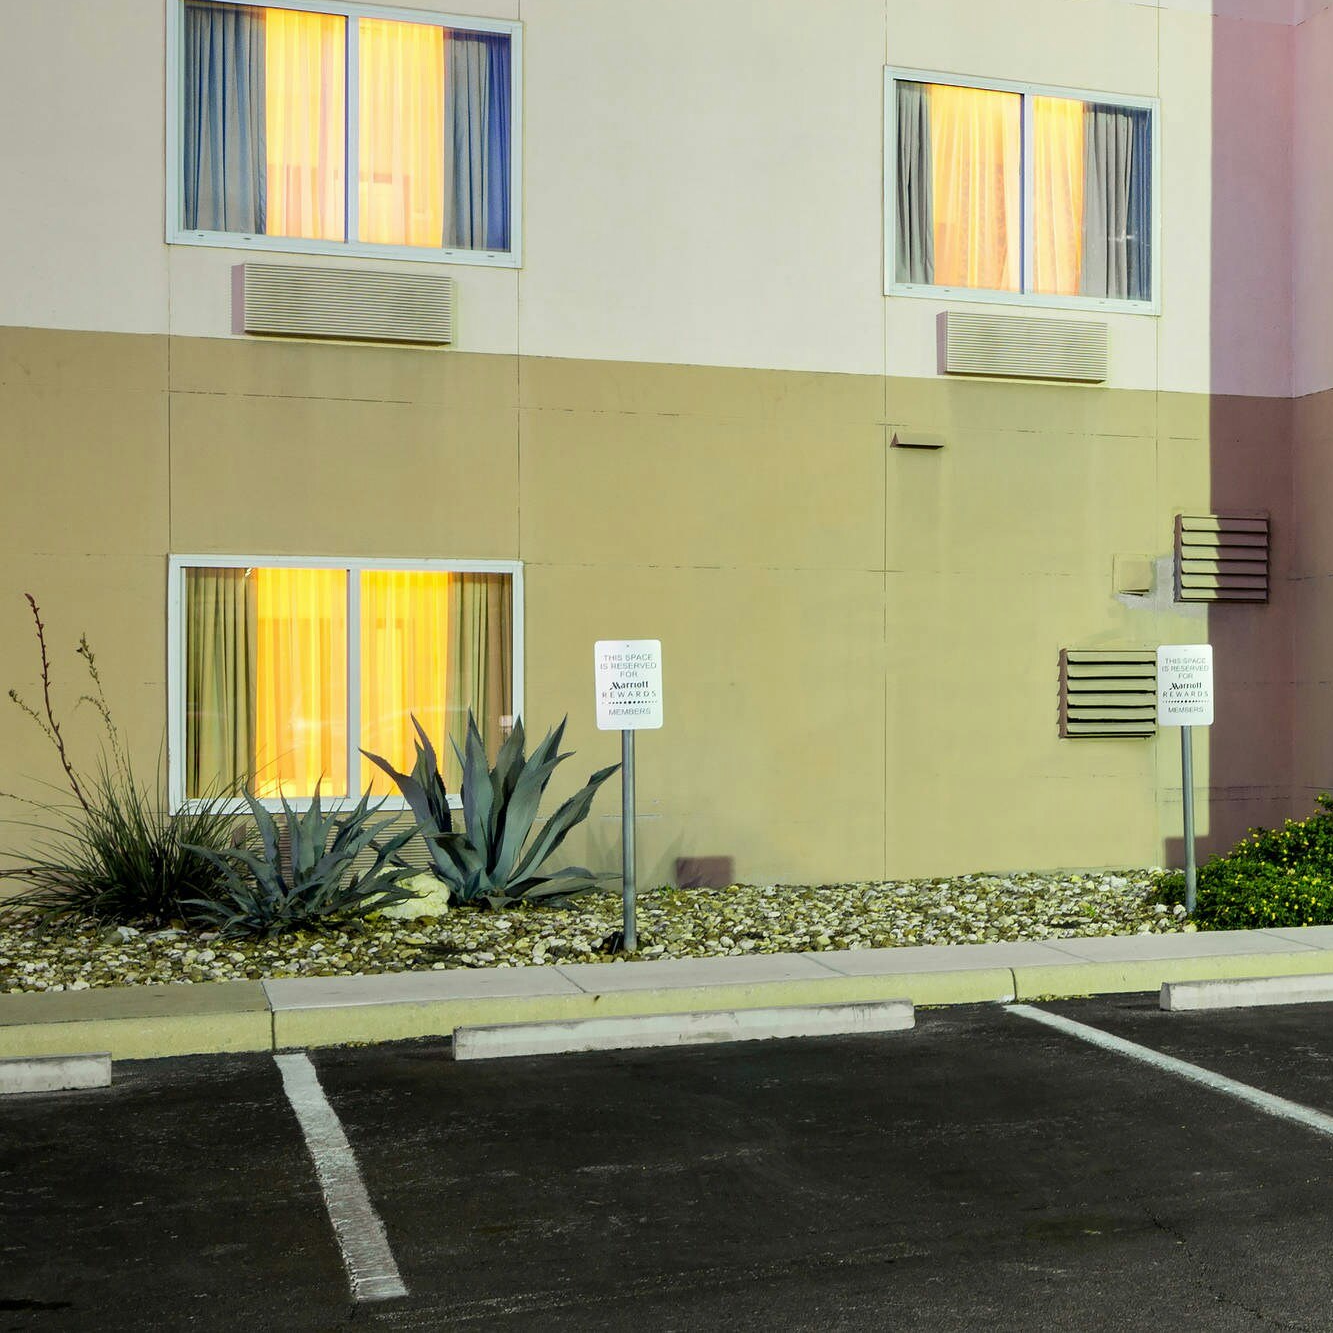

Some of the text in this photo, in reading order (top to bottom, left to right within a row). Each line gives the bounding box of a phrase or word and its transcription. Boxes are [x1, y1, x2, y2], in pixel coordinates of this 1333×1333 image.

[604, 653, 653, 662] THIS SPACE
[600, 662, 657, 670] IS RESERVED
[620, 670, 638, 678] FOR
[609, 681, 649, 691] Marriott
[1169, 682, 1202, 690] Marriott
[602, 690, 657, 698] REWARDS
[608, 708, 651, 716] MEMBERS
